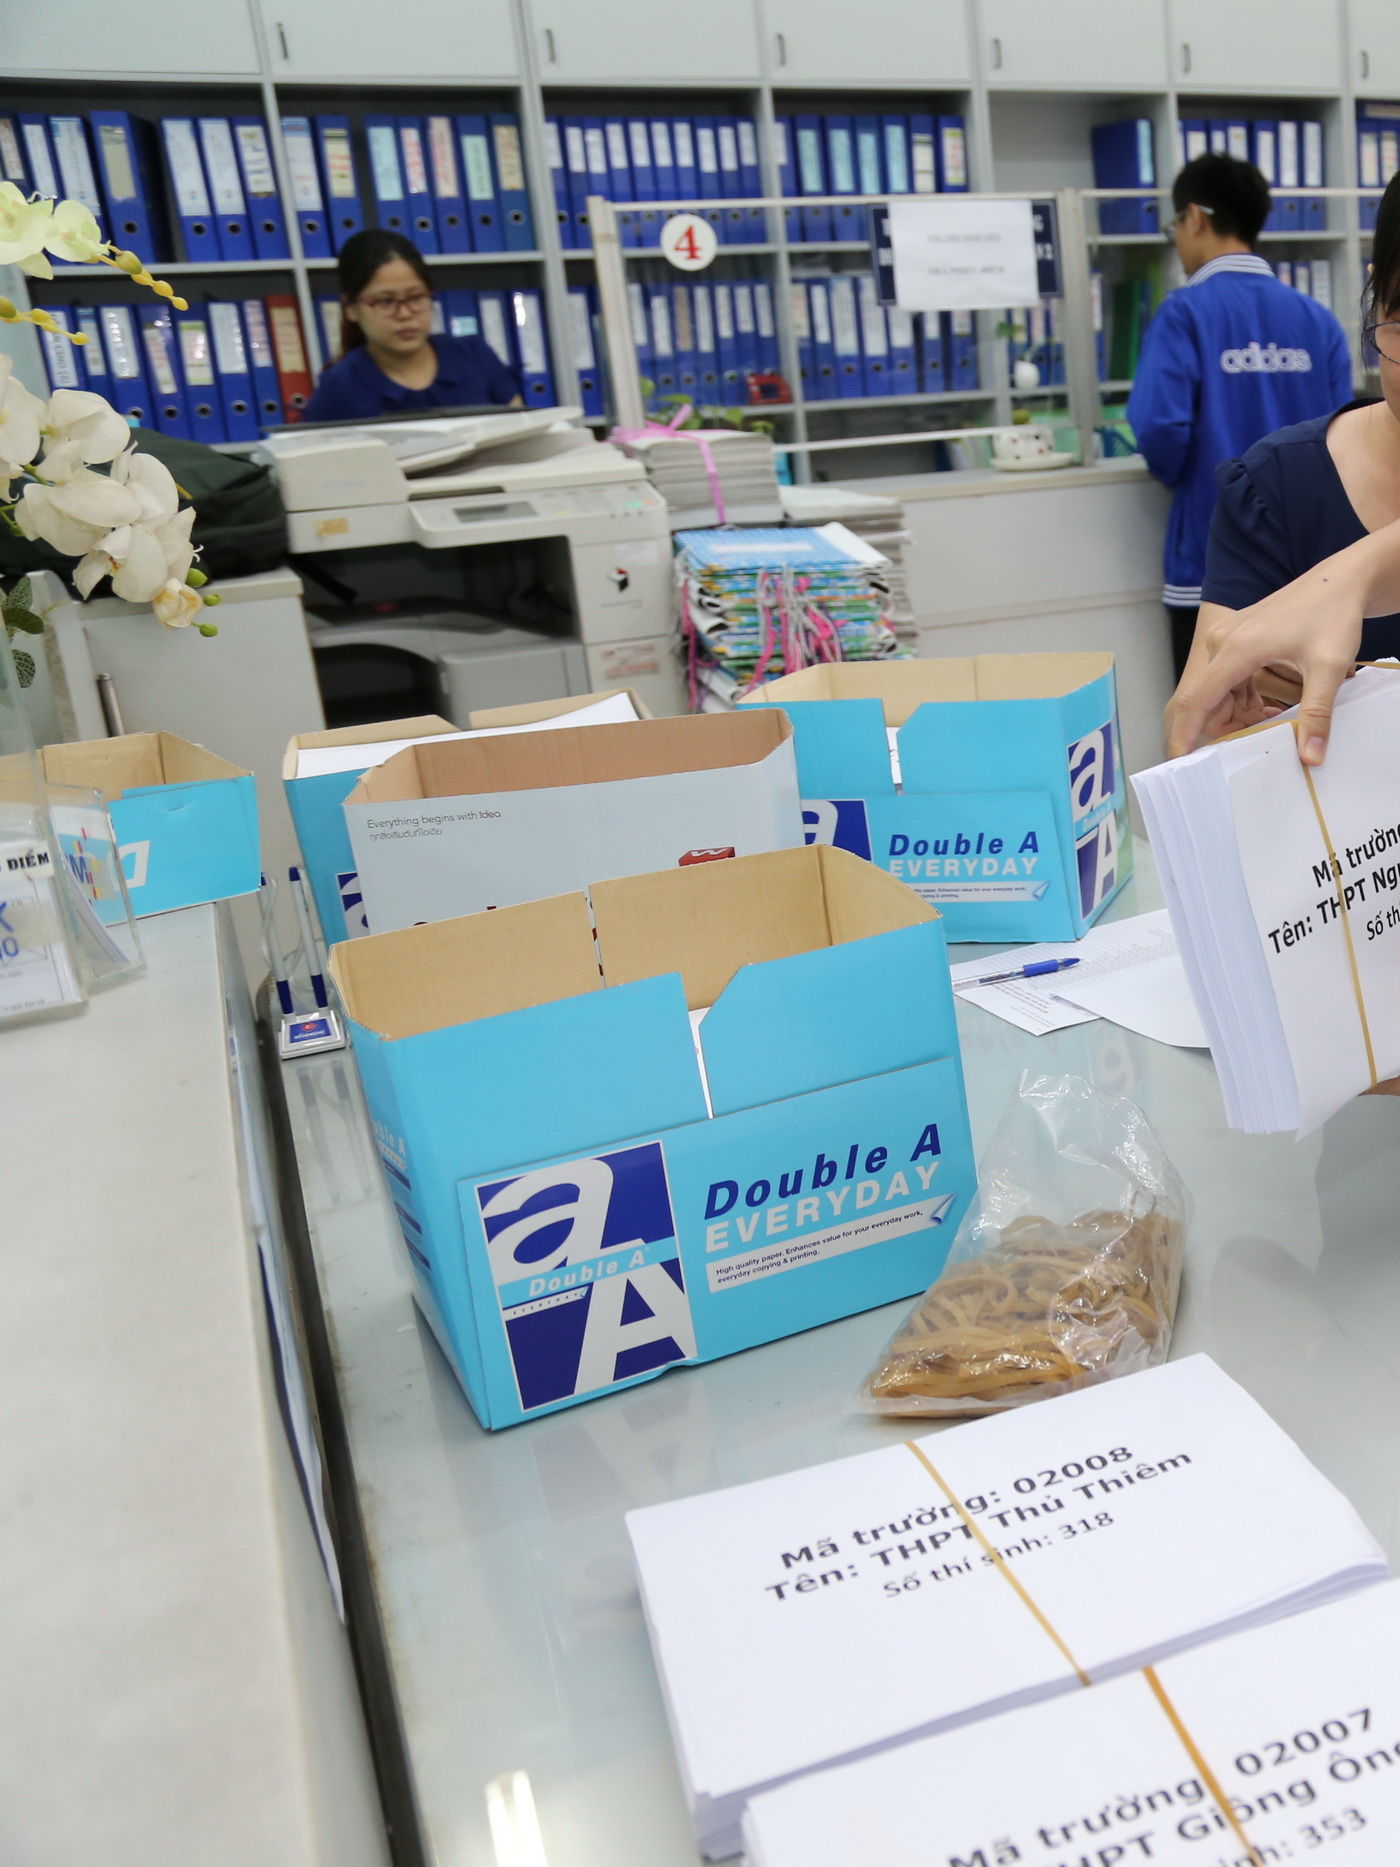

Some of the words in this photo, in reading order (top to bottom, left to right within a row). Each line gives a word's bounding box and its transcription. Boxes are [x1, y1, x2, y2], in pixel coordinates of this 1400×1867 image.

[674, 226, 702, 260] 4
[1220, 341, 1312, 374] adidas
[367, 816, 419, 828] Everything
[421, 814, 455, 825] begins
[457, 811, 478, 821] with
[889, 832, 1004, 857] Double
[1018, 831, 1039, 855] A
[890, 857, 1039, 878] EVERYDAY
[1312, 853, 1343, 888] Mã
[1268, 916, 1313, 954] Tên:
[1317, 878, 1366, 925] THPT
[1366, 911, 1384, 940] Số
[704, 1143, 888, 1220] Double
[909, 1123, 942, 1162] A
[706, 1161, 940, 1254] EVERYDAY
[716, 1262, 734, 1276] High
[735, 1256, 760, 1271] quality
[761, 1251, 784, 1267] paper.
[785, 1240, 821, 1255] Enhances
[822, 1233, 841, 1244] value
[842, 1230, 853, 1239] for
[854, 1224, 870, 1236] your
[871, 1216, 902, 1230] everyday
[903, 1210, 924, 1220] work,
[529, 1260, 618, 1297] Double
[628, 1250, 645, 1269] A
[717, 1269, 751, 1284] everyday
[752, 1260, 781, 1275] copying
[789, 1249, 820, 1264] printing.
[764, 1561, 860, 1602] Tên:
[869, 1523, 976, 1568] THPT
[988, 1493, 1065, 1530] Thủ
[1072, 1451, 1193, 1502] Thiêm
[780, 1536, 840, 1570] Mã
[851, 1488, 1001, 1547] trường:
[1012, 1445, 1133, 1496] 02008
[883, 1570, 922, 1599] Số
[930, 1557, 972, 1583] thí
[980, 1532, 1053, 1567] sinh:
[1060, 1511, 1115, 1541] 318
[1233, 1707, 1374, 1776] 02007
[1298, 1807, 1368, 1850] 353
